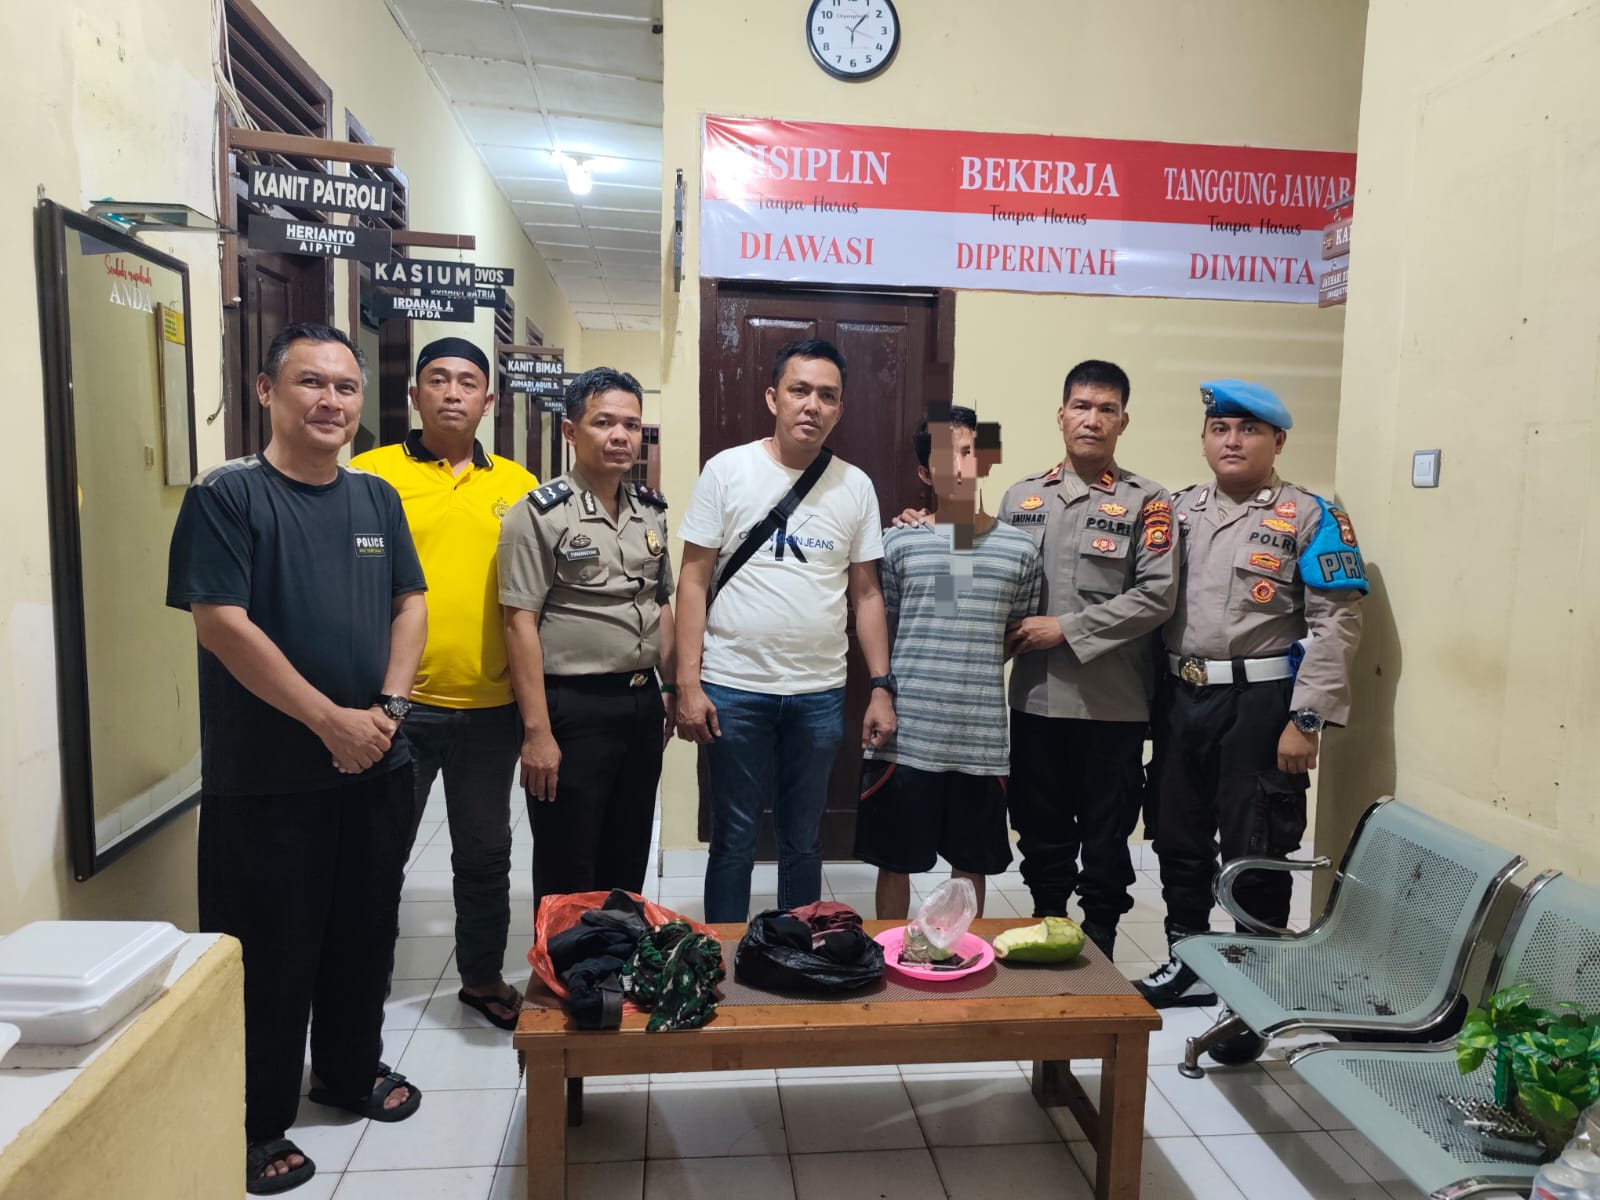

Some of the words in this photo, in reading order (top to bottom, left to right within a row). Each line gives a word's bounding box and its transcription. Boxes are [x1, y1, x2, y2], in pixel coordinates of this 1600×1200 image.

[821, 10, 833, 19] 10
[876, 10, 882, 18] 2
[818, 26, 824, 35] 9
[881, 27, 887, 35] 3
[823, 43, 830, 51] 8
[876, 43, 883, 51] 4
[850, 59, 857, 68] 6
[866, 55, 872, 63] 5
[735, 143, 891, 185] ISIPLIN
[960, 156, 1120, 197] BEKERJA
[254, 171, 309, 202] KANIT
[313, 179, 386, 212] PATROLI
[1164, 168, 1277, 206] TANGGUNG
[759, 193, 805, 214] Tanpa
[813, 195, 858, 214] Harus
[989, 204, 1036, 226] Tanpa
[1043, 207, 1087, 226] Harus
[286, 224, 355, 244] HERIANTO
[1208, 215, 1252, 237] Tanpa
[1260, 217, 1302, 236] Harus
[299, 242, 341, 255] AIPTU
[740, 232, 874, 265] DIAWASI
[956, 242, 1116, 276] DIPERINTAH
[1189, 252, 1314, 285] DIMINTA
[375, 262, 471, 286] KASIUM
[109, 282, 153, 314] ANDA
[393, 297, 443, 310] IRDANAL
[407, 309, 441, 319] AIPDA
[508, 360, 534, 372] KANIT
[535, 362, 562, 374] BIMAS
[1086, 517, 1131, 536] POLRI
[356, 537, 384, 548] POLICE
[804, 538, 834, 551] JEANS
[1249, 531, 1297, 554] POLRI
[1318, 552, 1367, 582] PR
